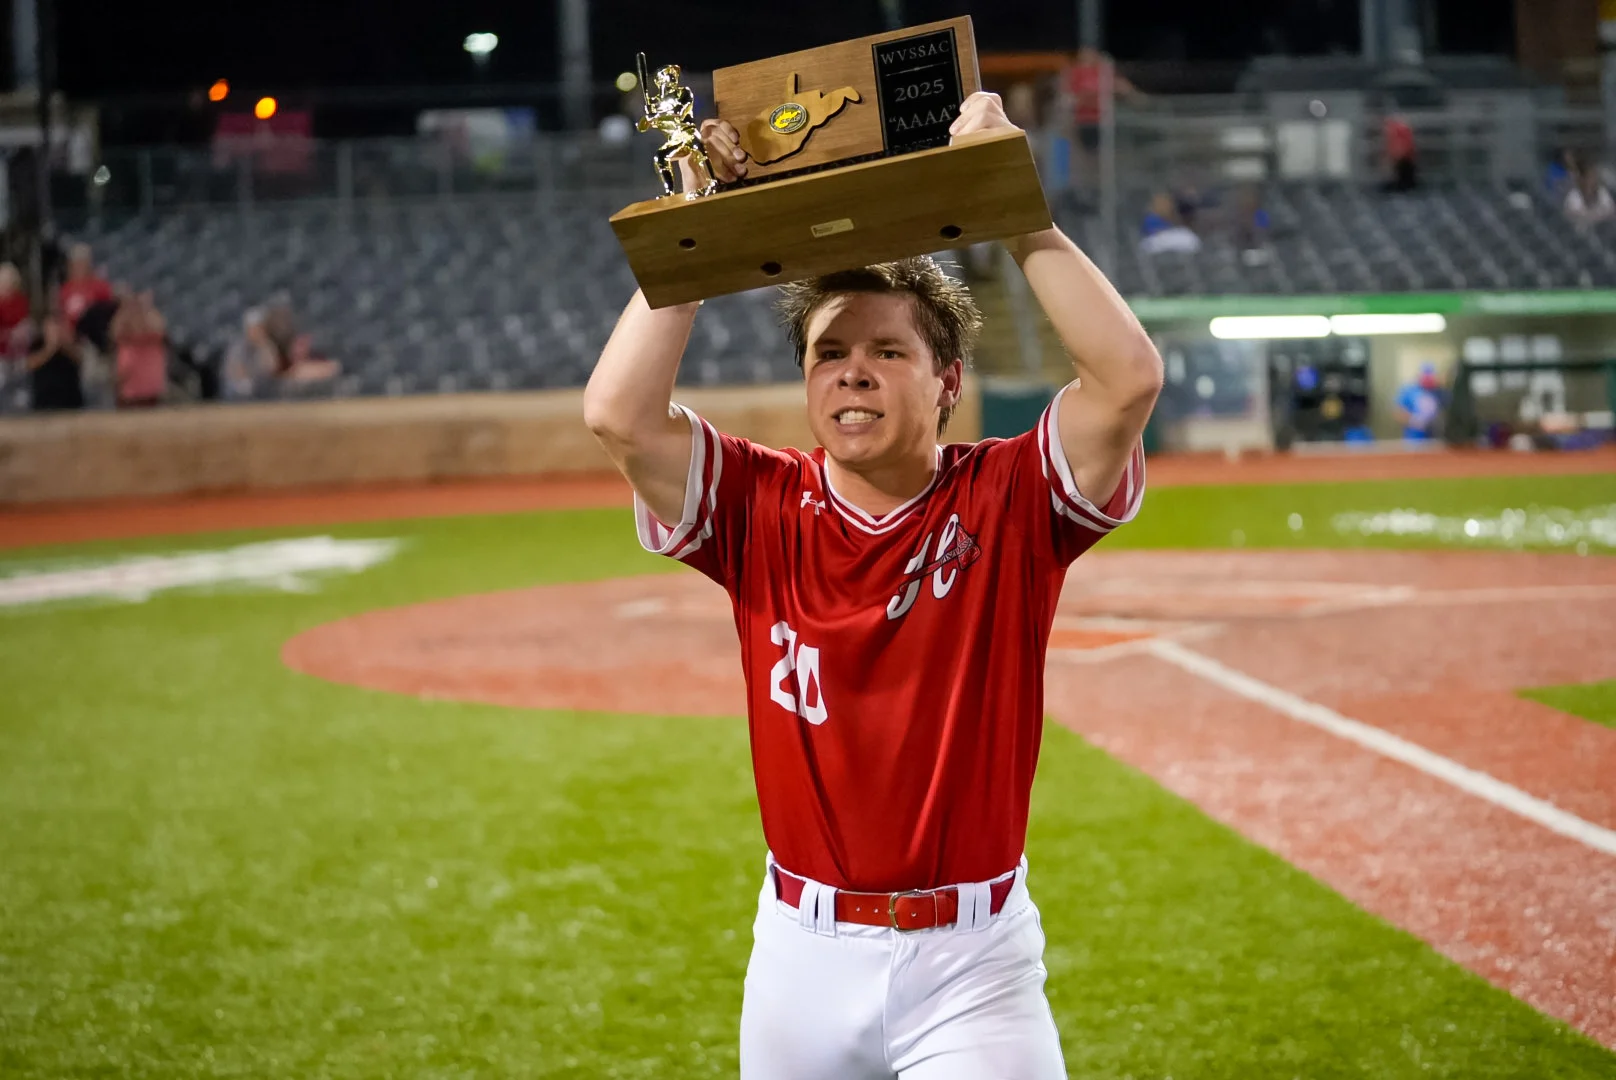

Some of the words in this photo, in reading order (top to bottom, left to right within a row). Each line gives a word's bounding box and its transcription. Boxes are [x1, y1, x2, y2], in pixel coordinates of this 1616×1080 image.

[881, 40, 950, 65] WVSSAC
[894, 79, 945, 102] 2025
[770, 620, 828, 725] 20
